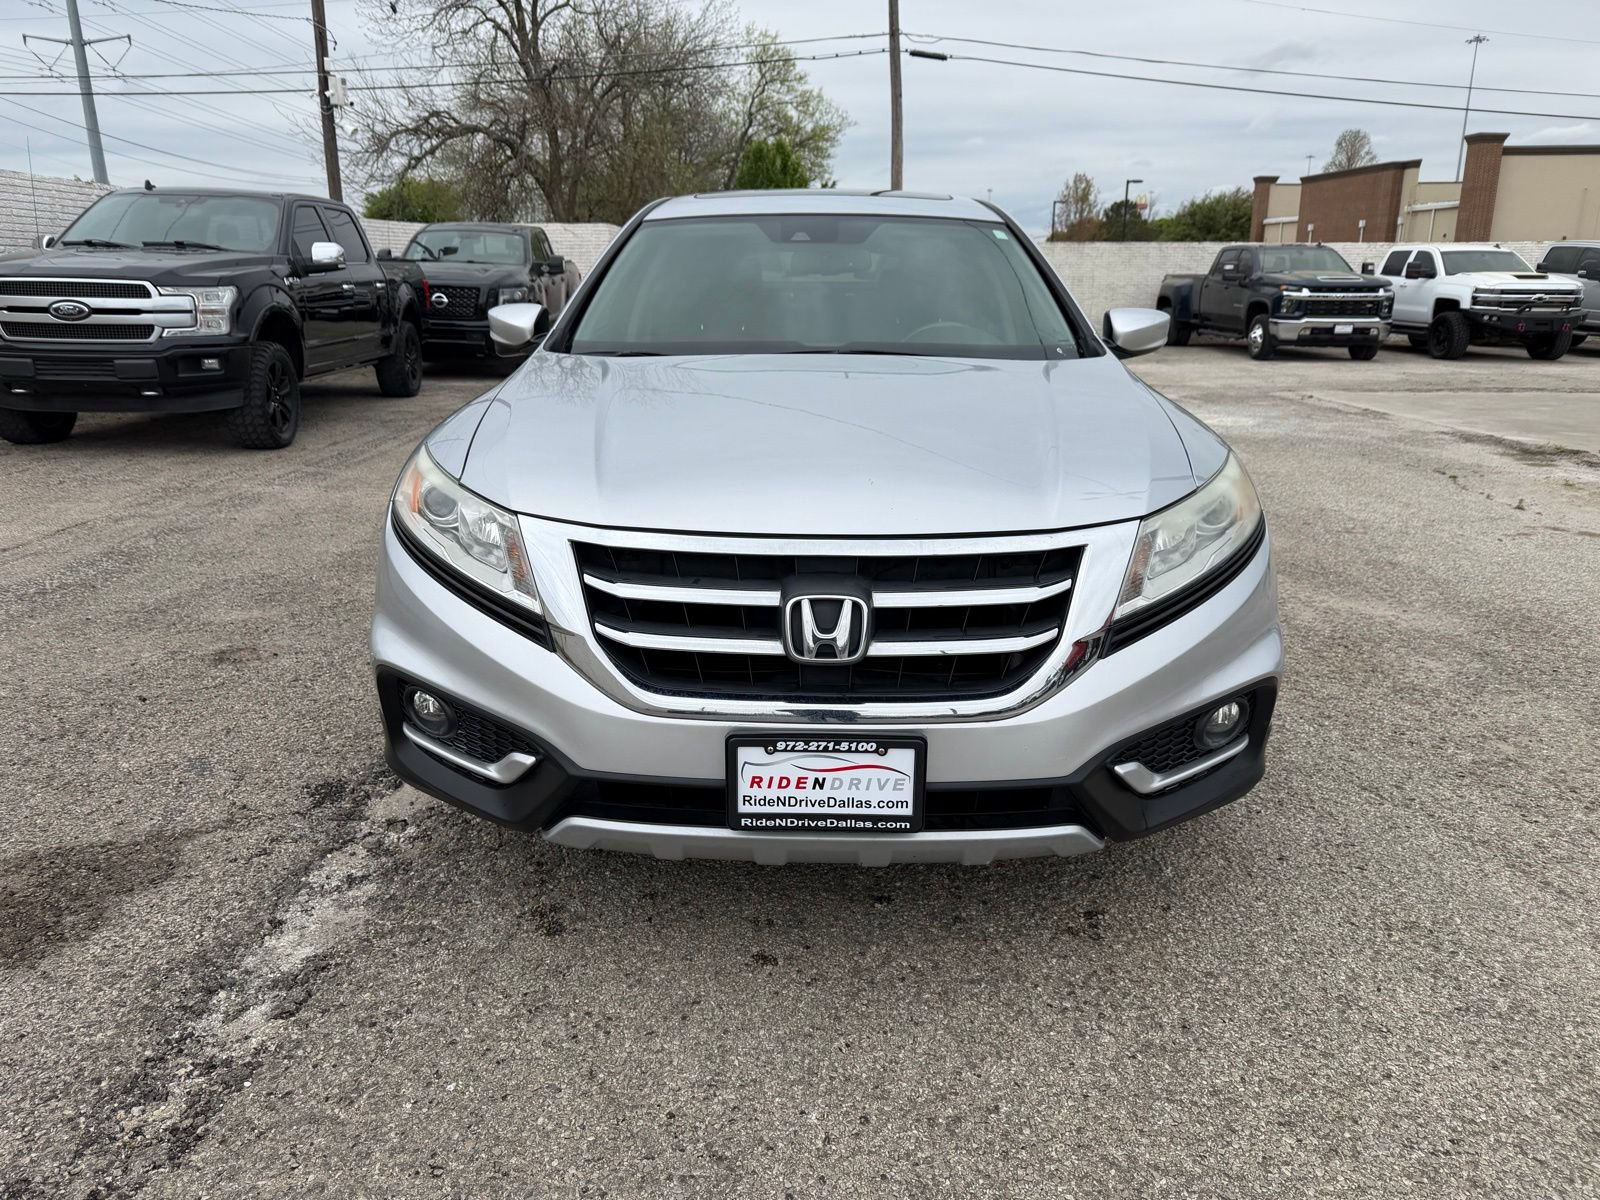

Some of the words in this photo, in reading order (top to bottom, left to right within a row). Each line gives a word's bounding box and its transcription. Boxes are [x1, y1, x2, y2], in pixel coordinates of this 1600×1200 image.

[776, 741, 877, 752] 972-271-5100
[742, 795, 909, 809] RideNDriveDallas.com
[740, 818, 911, 829] RideNDriveDallas.com
